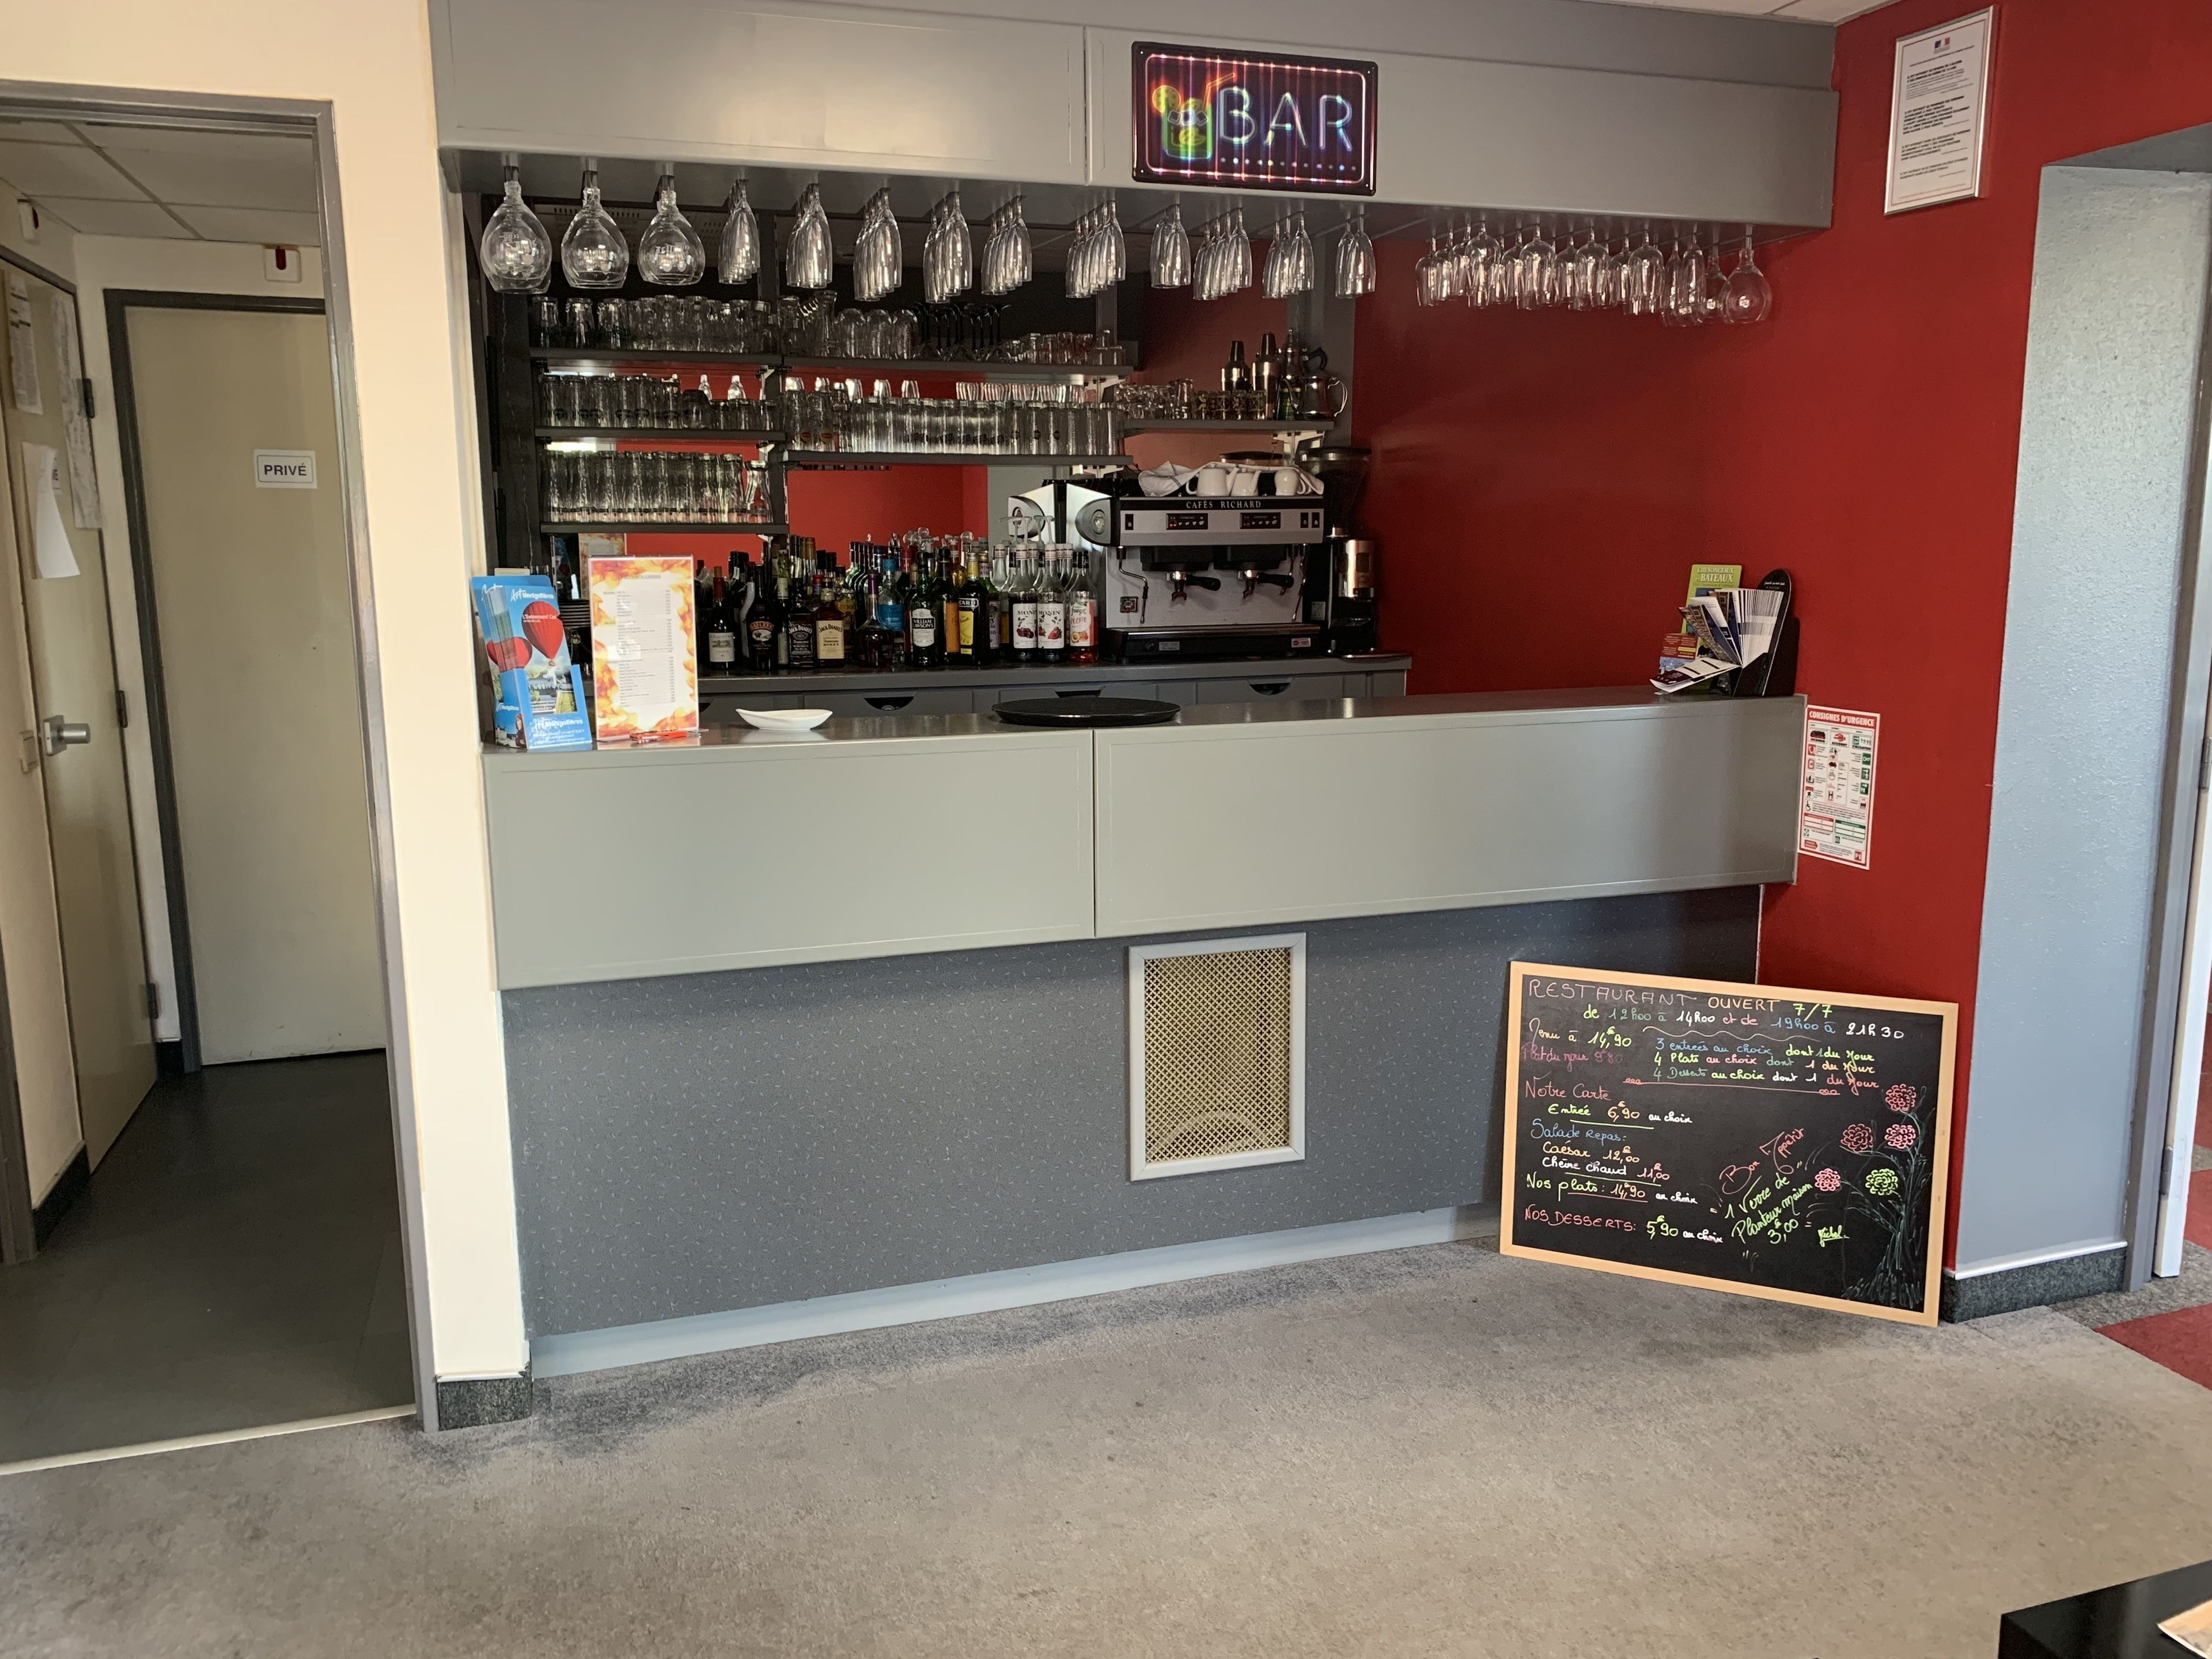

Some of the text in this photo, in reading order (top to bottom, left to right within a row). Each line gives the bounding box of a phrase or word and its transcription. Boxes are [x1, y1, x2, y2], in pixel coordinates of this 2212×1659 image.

[1218, 85, 1353, 152] BAR
[264, 463, 307, 476] PRIVÉ
[1186, 500, 1262, 509] CAFÉS RICHARD
[1700, 573, 1733, 582] BATEAUX
[510, 588, 526, 602] Art
[789, 626, 798, 634] JACK
[819, 624, 843, 633] JACK DANIEL'S
[1809, 710, 1875, 727] CONSIGNES D'URGENCE
[1529, 979, 1832, 1022] RESTAURANT OUVERT 7/7
[1584, 1003, 1600, 1019] de
[1676, 1010, 1715, 1027] 14h00
[1722, 1012, 1737, 1024] et
[1740, 1014, 1759, 1025] de
[1770, 1017, 1819, 1029] 19h00
[1656, 1037, 1664, 1051] 3
[1737, 1043, 1773, 1055] choix
[1786, 1044, 1814, 1056] dont
[1824, 1046, 1840, 1059] du
[1654, 1051, 1662, 1066] 4
[1671, 1052, 1699, 1063] Plats
[1725, 1054, 1757, 1065] choix
[1766, 1055, 1795, 1066] dont
[1805, 1060, 1815, 1069] 1
[1821, 1060, 1839, 1071] du
[1525, 1070, 1612, 1101] Notre Carte
[1653, 1067, 1662, 1082] 4
[1666, 1067, 1709, 1079] Desserts
[1730, 1069, 1766, 1080] choix
[1772, 1071, 1798, 1082] dont
[1805, 1073, 1817, 1082] 1
[1827, 1073, 1844, 1085] du
[1649, 1113, 1661, 1122] au
[1664, 1111, 1693, 1123] choix
[1531, 1118, 1580, 1139] Salade
[1585, 1161, 1627, 1176] chaud
[1719, 1161, 1760, 1195] Bon
[1527, 1171, 1551, 1190] Nos
[1656, 1192, 1668, 1201] au
[1670, 1191, 1698, 1205] choix
[1725, 1203, 1735, 1219] 1
[1775, 1172, 1790, 1190] de
[1731, 1183, 1813, 1244] Planteur maison
[1525, 1204, 1549, 1221] NOS
[1683, 1230, 1695, 1238] au
[1696, 1229, 1724, 1244] choix
